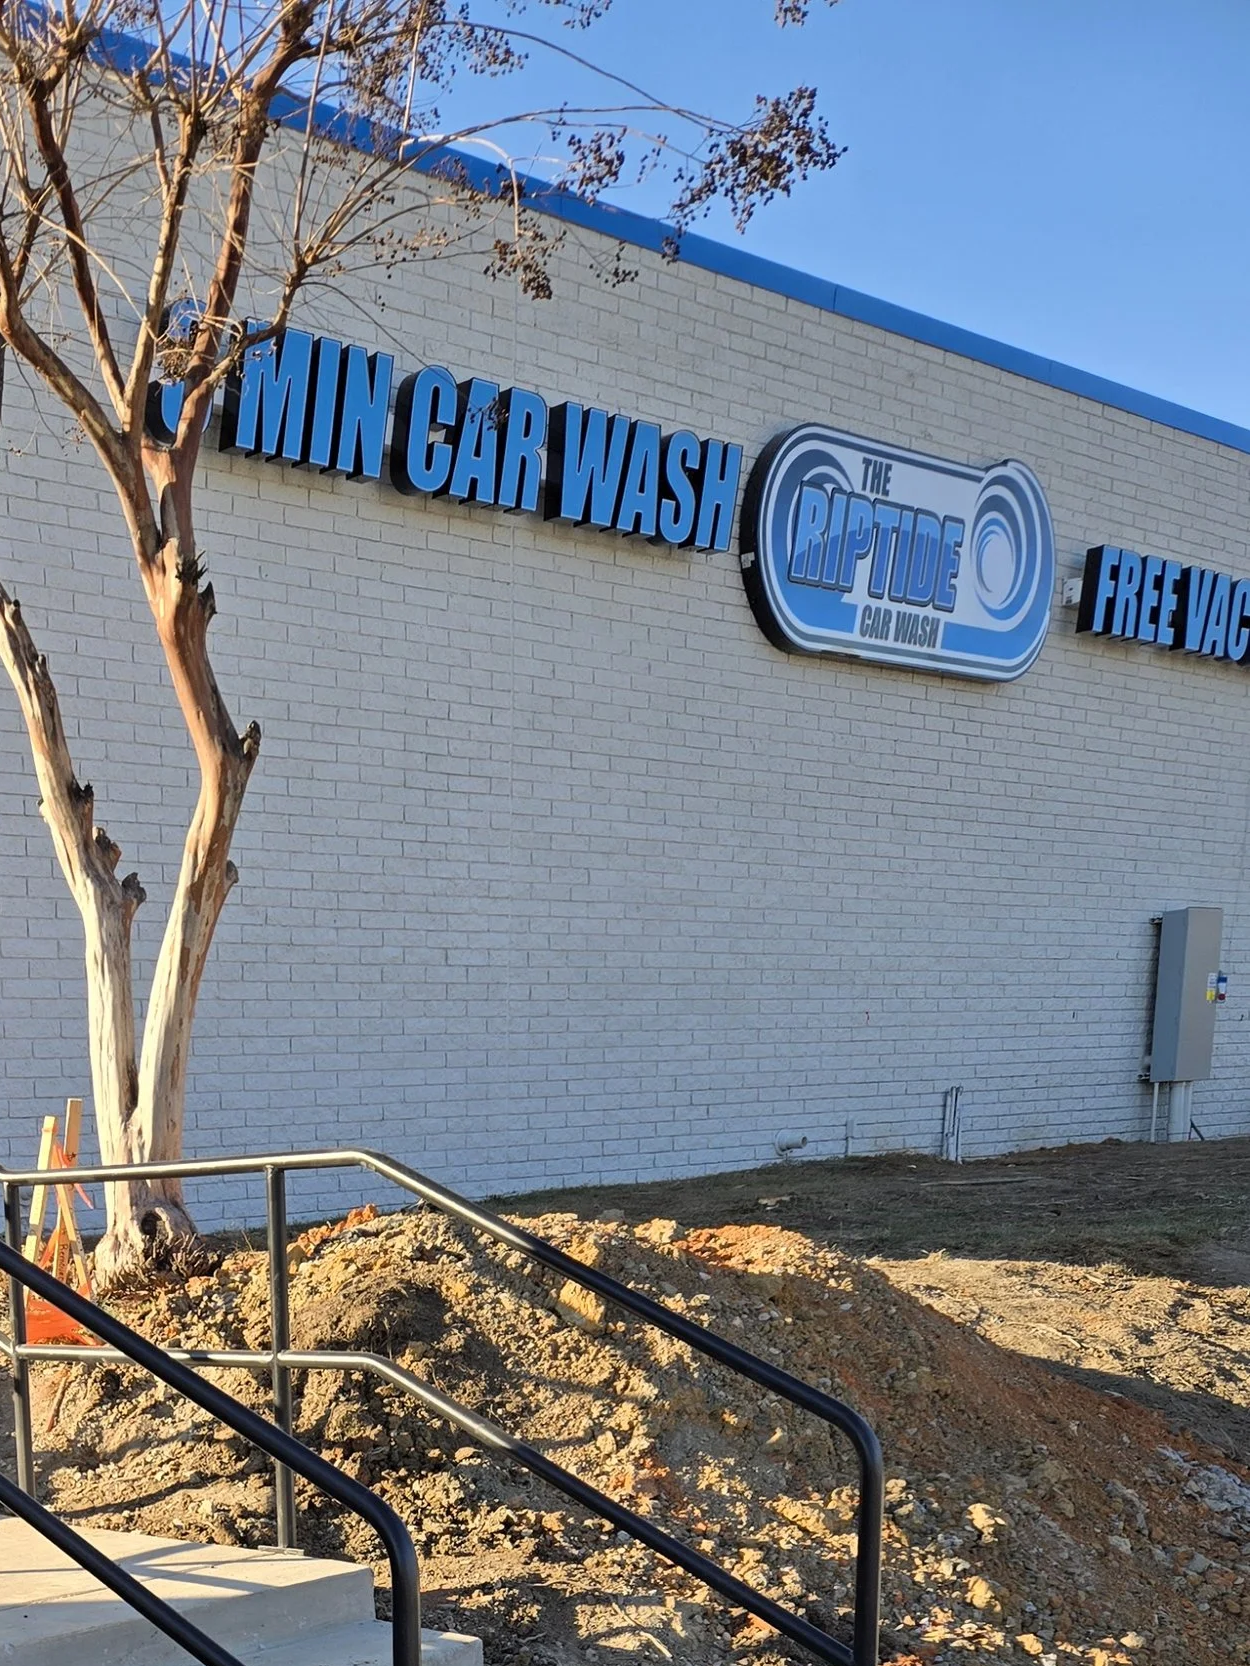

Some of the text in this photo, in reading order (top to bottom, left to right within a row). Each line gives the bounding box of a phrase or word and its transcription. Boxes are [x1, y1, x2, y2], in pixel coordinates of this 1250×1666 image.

[234, 316, 395, 479] MIN
[406, 364, 549, 513] CAR
[560, 400, 744, 552] WASH
[861, 456, 893, 497] THE
[787, 479, 966, 613] RIPTIDE
[1091, 544, 1184, 646] FREE
[859, 604, 941, 649] CAR WASH
